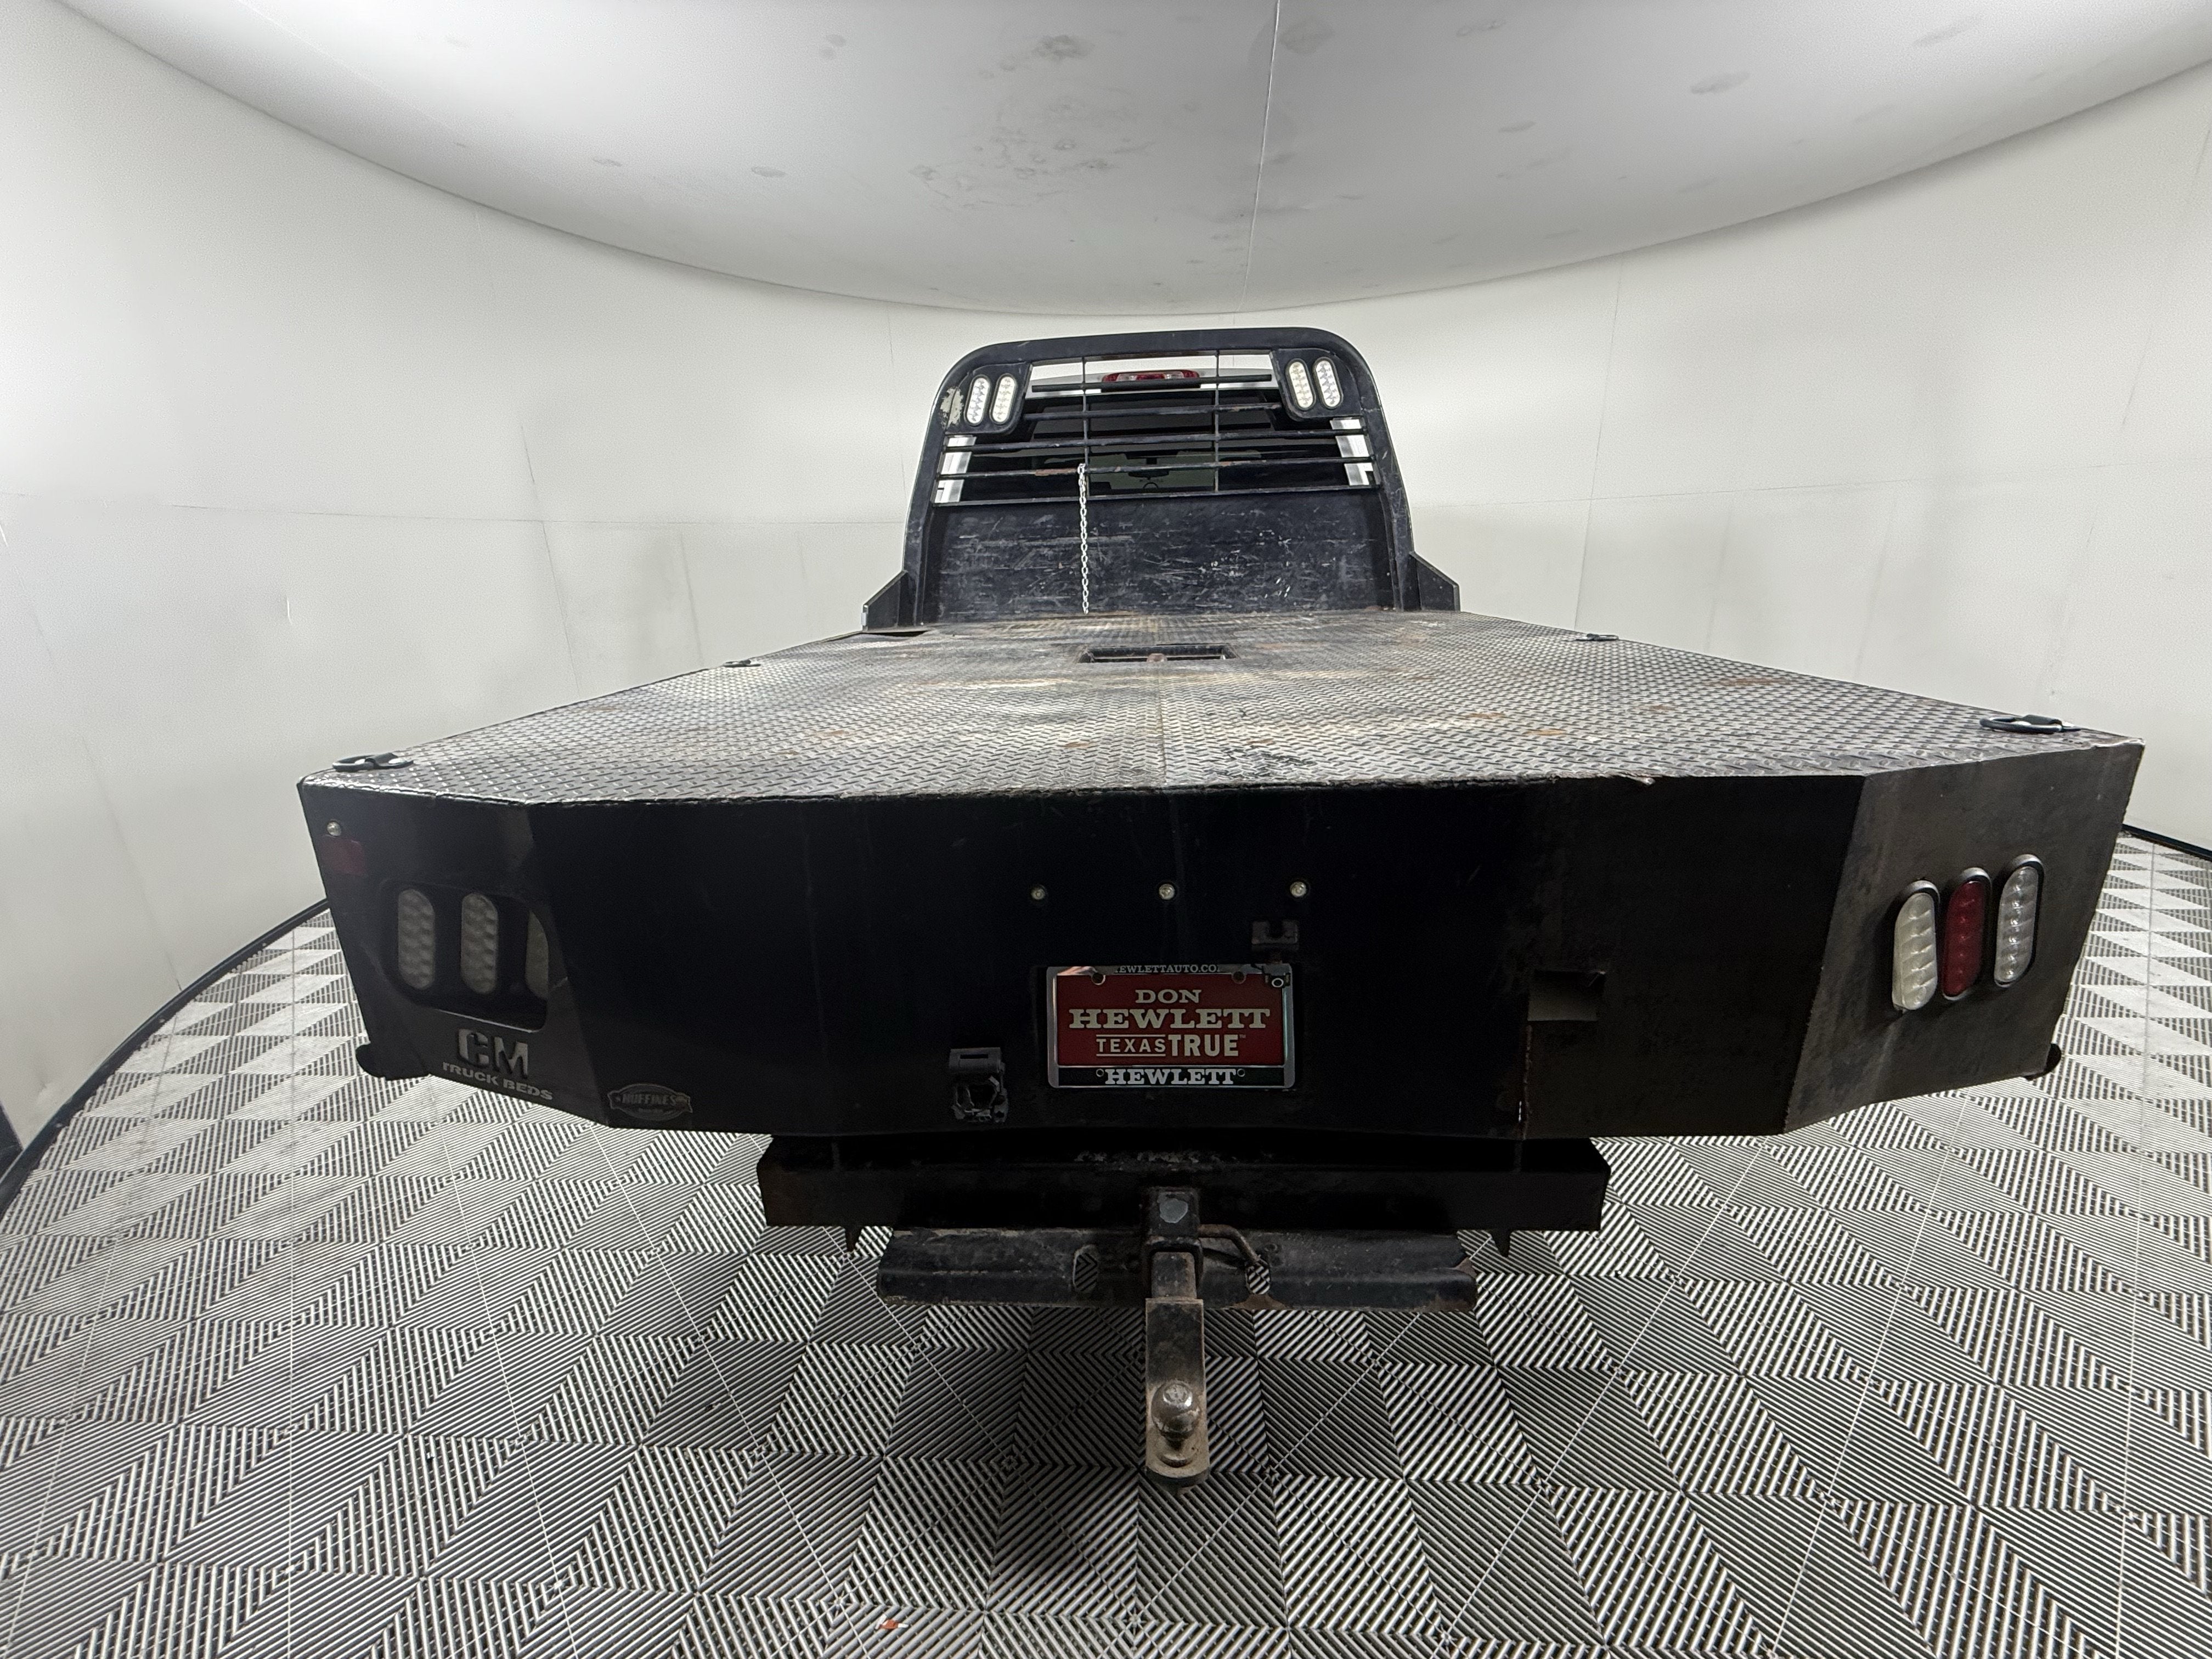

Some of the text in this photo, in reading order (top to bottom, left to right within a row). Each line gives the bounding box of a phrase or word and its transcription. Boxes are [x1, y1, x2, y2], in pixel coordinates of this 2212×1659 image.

[1135, 989, 1202, 1003] DON
[1069, 1008, 1271, 1029] HEWLETT
[458, 1028, 528, 1079] CM
[1096, 1038, 1166, 1053] TEXAS
[1168, 1034, 1239, 1056] TRUE
[443, 1062, 553, 1101] TRUCK BEDS
[1105, 1068, 1236, 1085] HEWLETT
